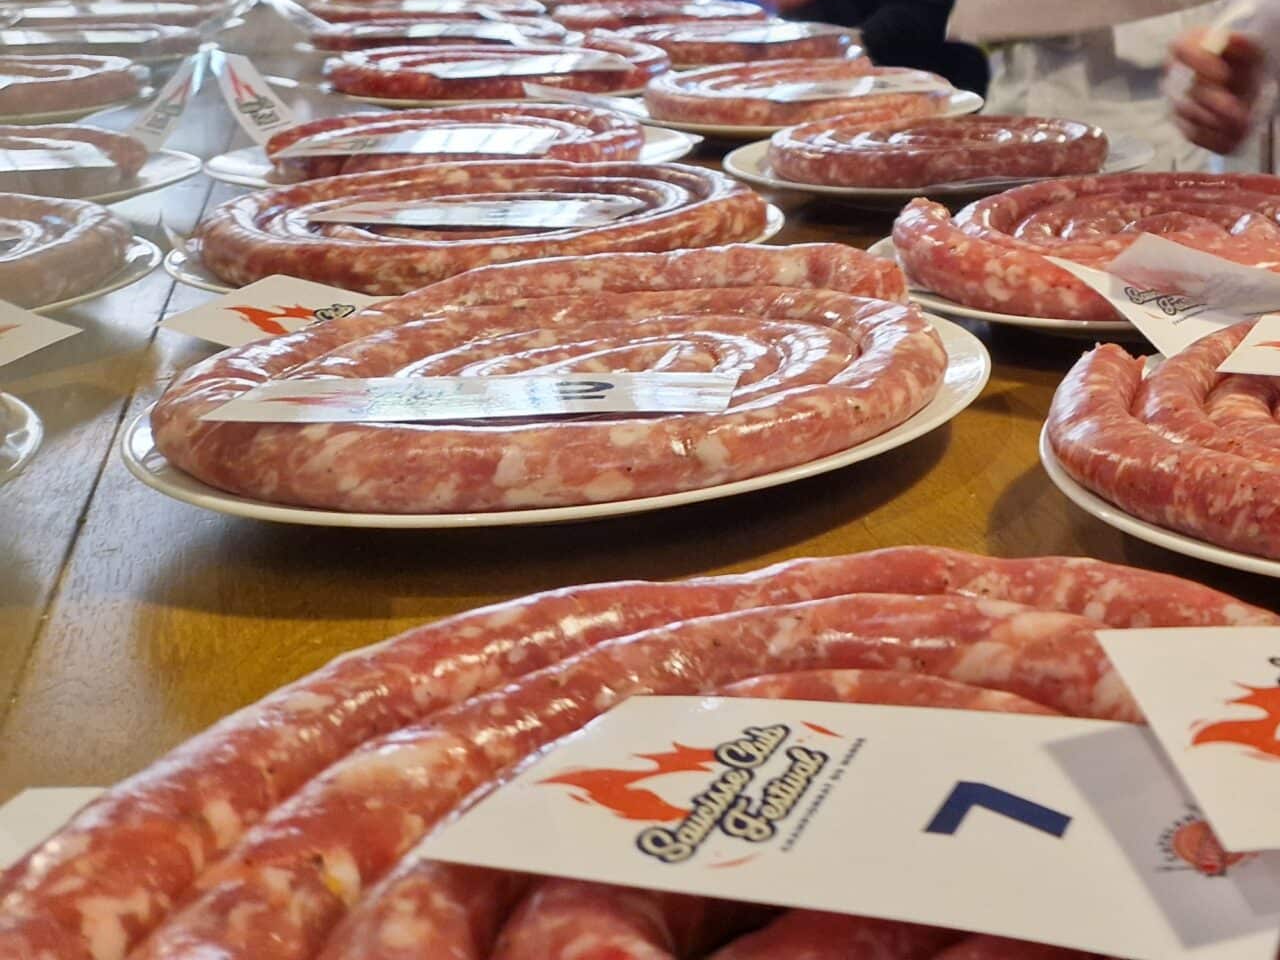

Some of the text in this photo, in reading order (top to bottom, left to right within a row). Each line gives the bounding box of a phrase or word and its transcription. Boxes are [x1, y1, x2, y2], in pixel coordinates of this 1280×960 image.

[636, 724, 791, 864] Saucisse Club
[719, 745, 829, 842] Festival
[923, 780, 1074, 839] 7
